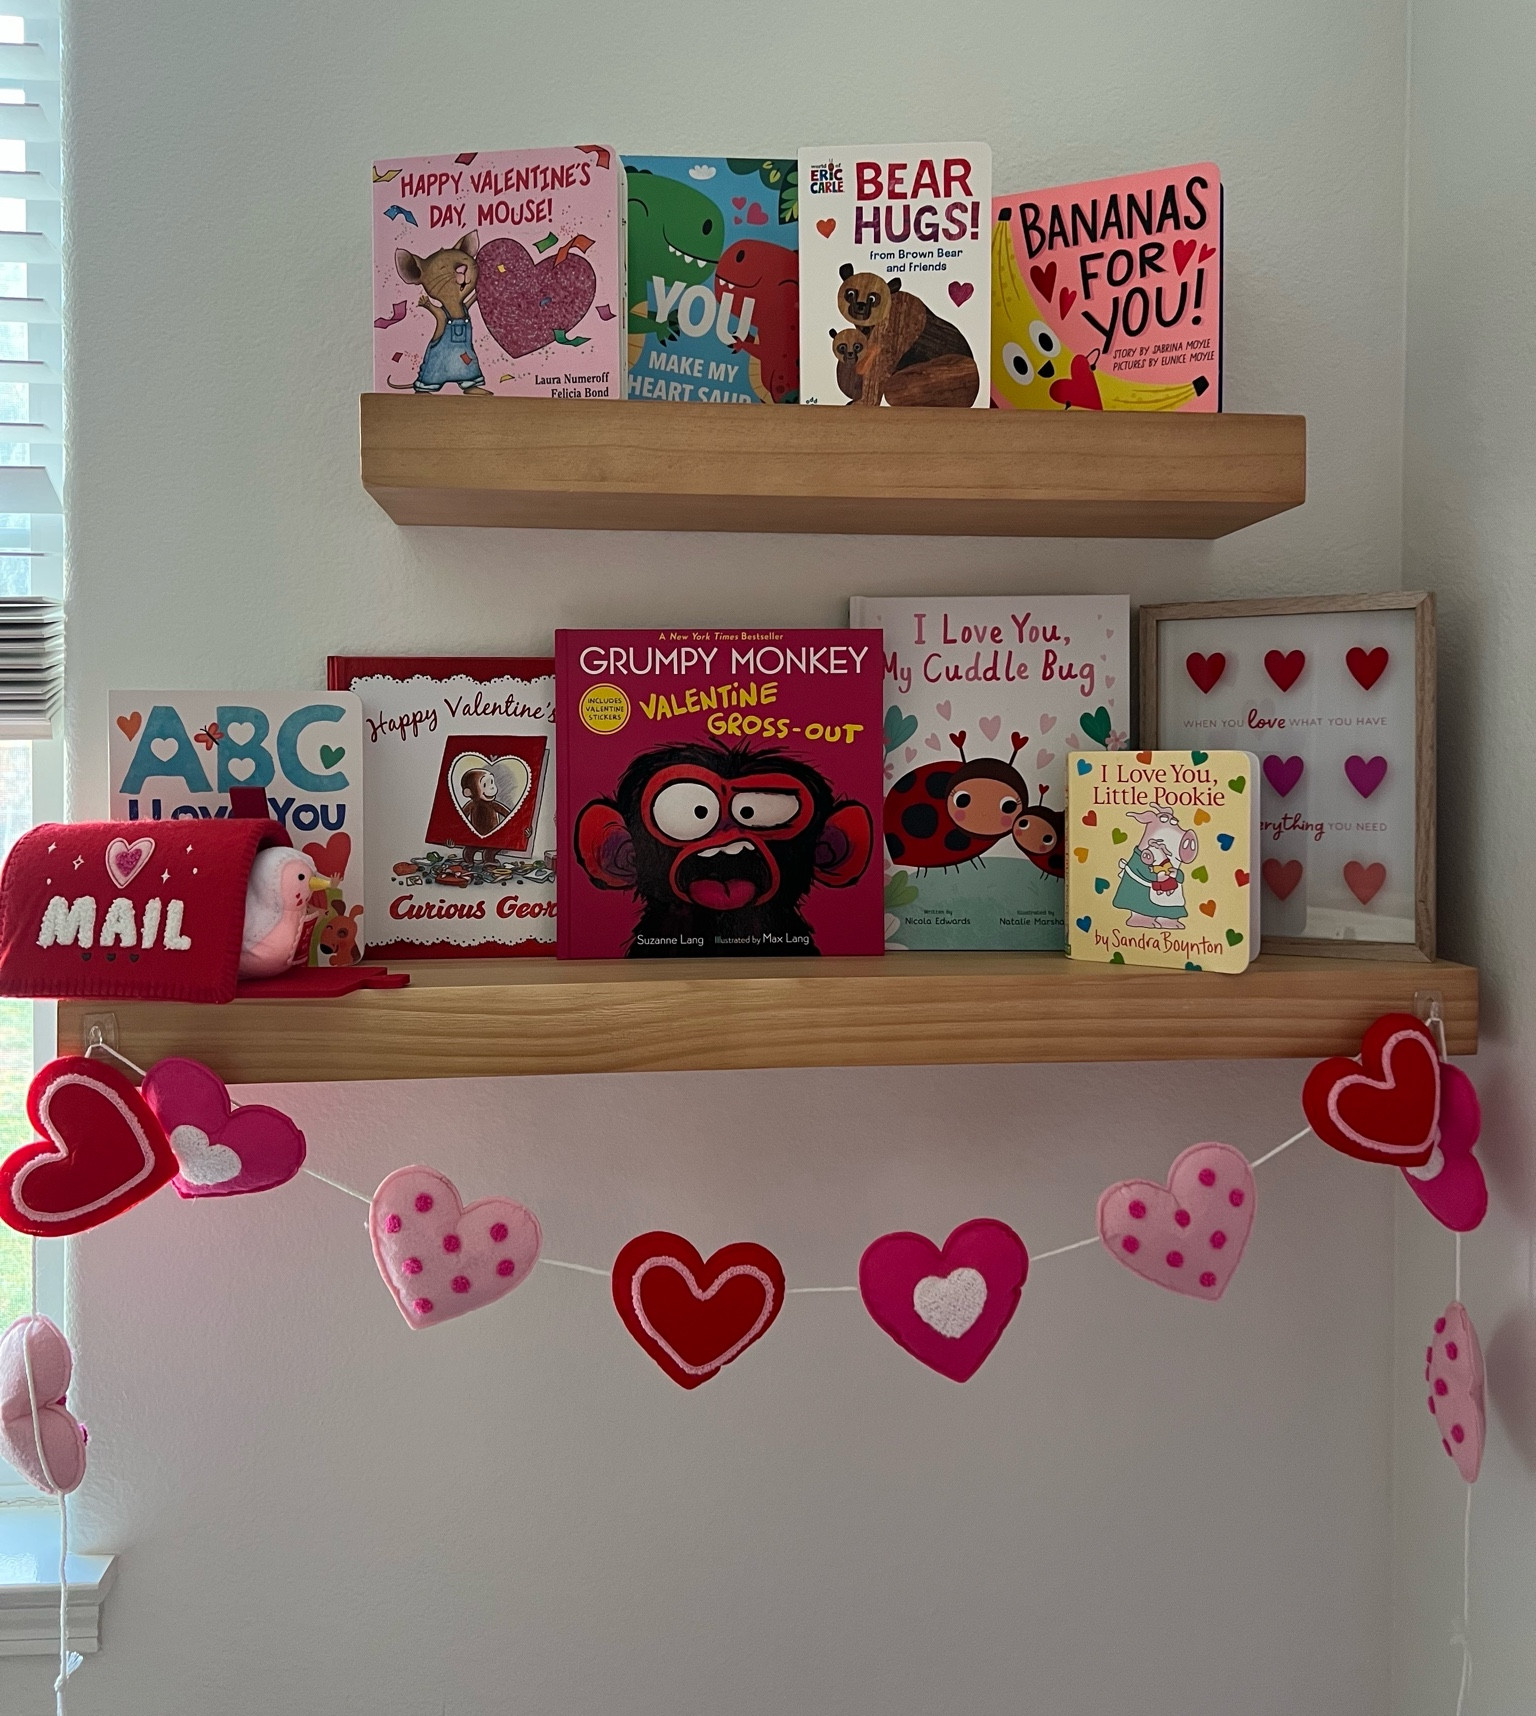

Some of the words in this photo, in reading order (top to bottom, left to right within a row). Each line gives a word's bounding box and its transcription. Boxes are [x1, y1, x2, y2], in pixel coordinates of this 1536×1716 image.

[401, 171, 463, 198] HAPPY
[471, 162, 591, 196] VALENTINE'S
[810, 181, 844, 194] CARLE
[811, 168, 843, 181] ERIC
[856, 158, 974, 202] BEAR
[430, 203, 466, 229] DAY,
[478, 198, 553, 227] MOUSE!
[854, 201, 980, 245] HUGS!
[1019, 176, 1208, 260] BANANAS
[870, 251, 895, 260] from
[898, 249, 934, 259] Brown
[937, 248, 963, 258] Bear
[886, 263, 905, 273] and
[1079, 242, 1167, 300] FOR
[652, 275, 756, 345] YOU
[1081, 268, 1205, 355] YOU!
[1112, 358, 1145, 371] PICTURES
[1148, 357, 1159, 367] BY
[1161, 355, 1186, 366] EUNICE
[1189, 350, 1215, 362] MOYLE
[1113, 348, 1137, 359] STORY
[1139, 346, 1150, 356] BY
[1152, 342, 1183, 354] SABRINA
[1186, 338, 1211, 350] MOYLE
[535, 374, 562, 385] Laura
[564, 372, 610, 384] Numeroff
[648, 351, 703, 378] MAKE
[708, 361, 739, 383] MY
[551, 388, 581, 398] Felicia
[585, 387, 609, 397] Bond
[628, 374, 694, 402] HEART
[659, 632, 666, 640] A
[669, 632, 689, 640] New
[692, 632, 711, 640] York
[714, 631, 739, 640] Times
[741, 631, 784, 640] Bestseller
[914, 613, 926, 645] I
[943, 613, 1003, 645] Love
[1011, 612, 1071, 646] You,
[579, 646, 718, 675] GRUMPY
[731, 646, 869, 675] MONKEY
[882, 651, 912, 694] My
[923, 650, 1030, 683] Cuddle
[1041, 649, 1095, 697] Bug
[366, 708, 437, 743] Happy
[444, 691, 556, 723] Valentine's
[707, 712, 864, 744] GROSS-OUT
[1183, 719, 1217, 728] WHEN
[1221, 719, 1244, 728] YOU
[1247, 708, 1286, 729] love
[1289, 717, 1323, 727] WHAT
[1327, 717, 1351, 726] YOU
[1356, 717, 1388, 726] HAVE
[118, 705, 350, 795] ABC
[1101, 764, 1107, 782] I
[1117, 764, 1167, 783] Love
[1170, 764, 1218, 787] You,
[1093, 786, 1148, 805] Little
[1153, 786, 1225, 806] Pookie
[1328, 822, 1351, 831] YOU
[1356, 822, 1388, 832] NEED
[389, 894, 486, 919] Curious
[36, 895, 192, 952] MAIL
[905, 917, 932, 925] Nicola
[935, 917, 971, 925] Edwards
[1000, 917, 1031, 926] Natalie
[637, 934, 678, 945] Suzanne
[680, 934, 704, 946] Lang
[715, 935, 750, 944] Illustrated
[751, 936, 761, 945] by
[762, 933, 783, 943] Max
[785, 933, 809, 945] Lang
[1094, 929, 1109, 951] by
[1111, 928, 1161, 951] Sandra
[1160, 931, 1223, 960] Boynton
